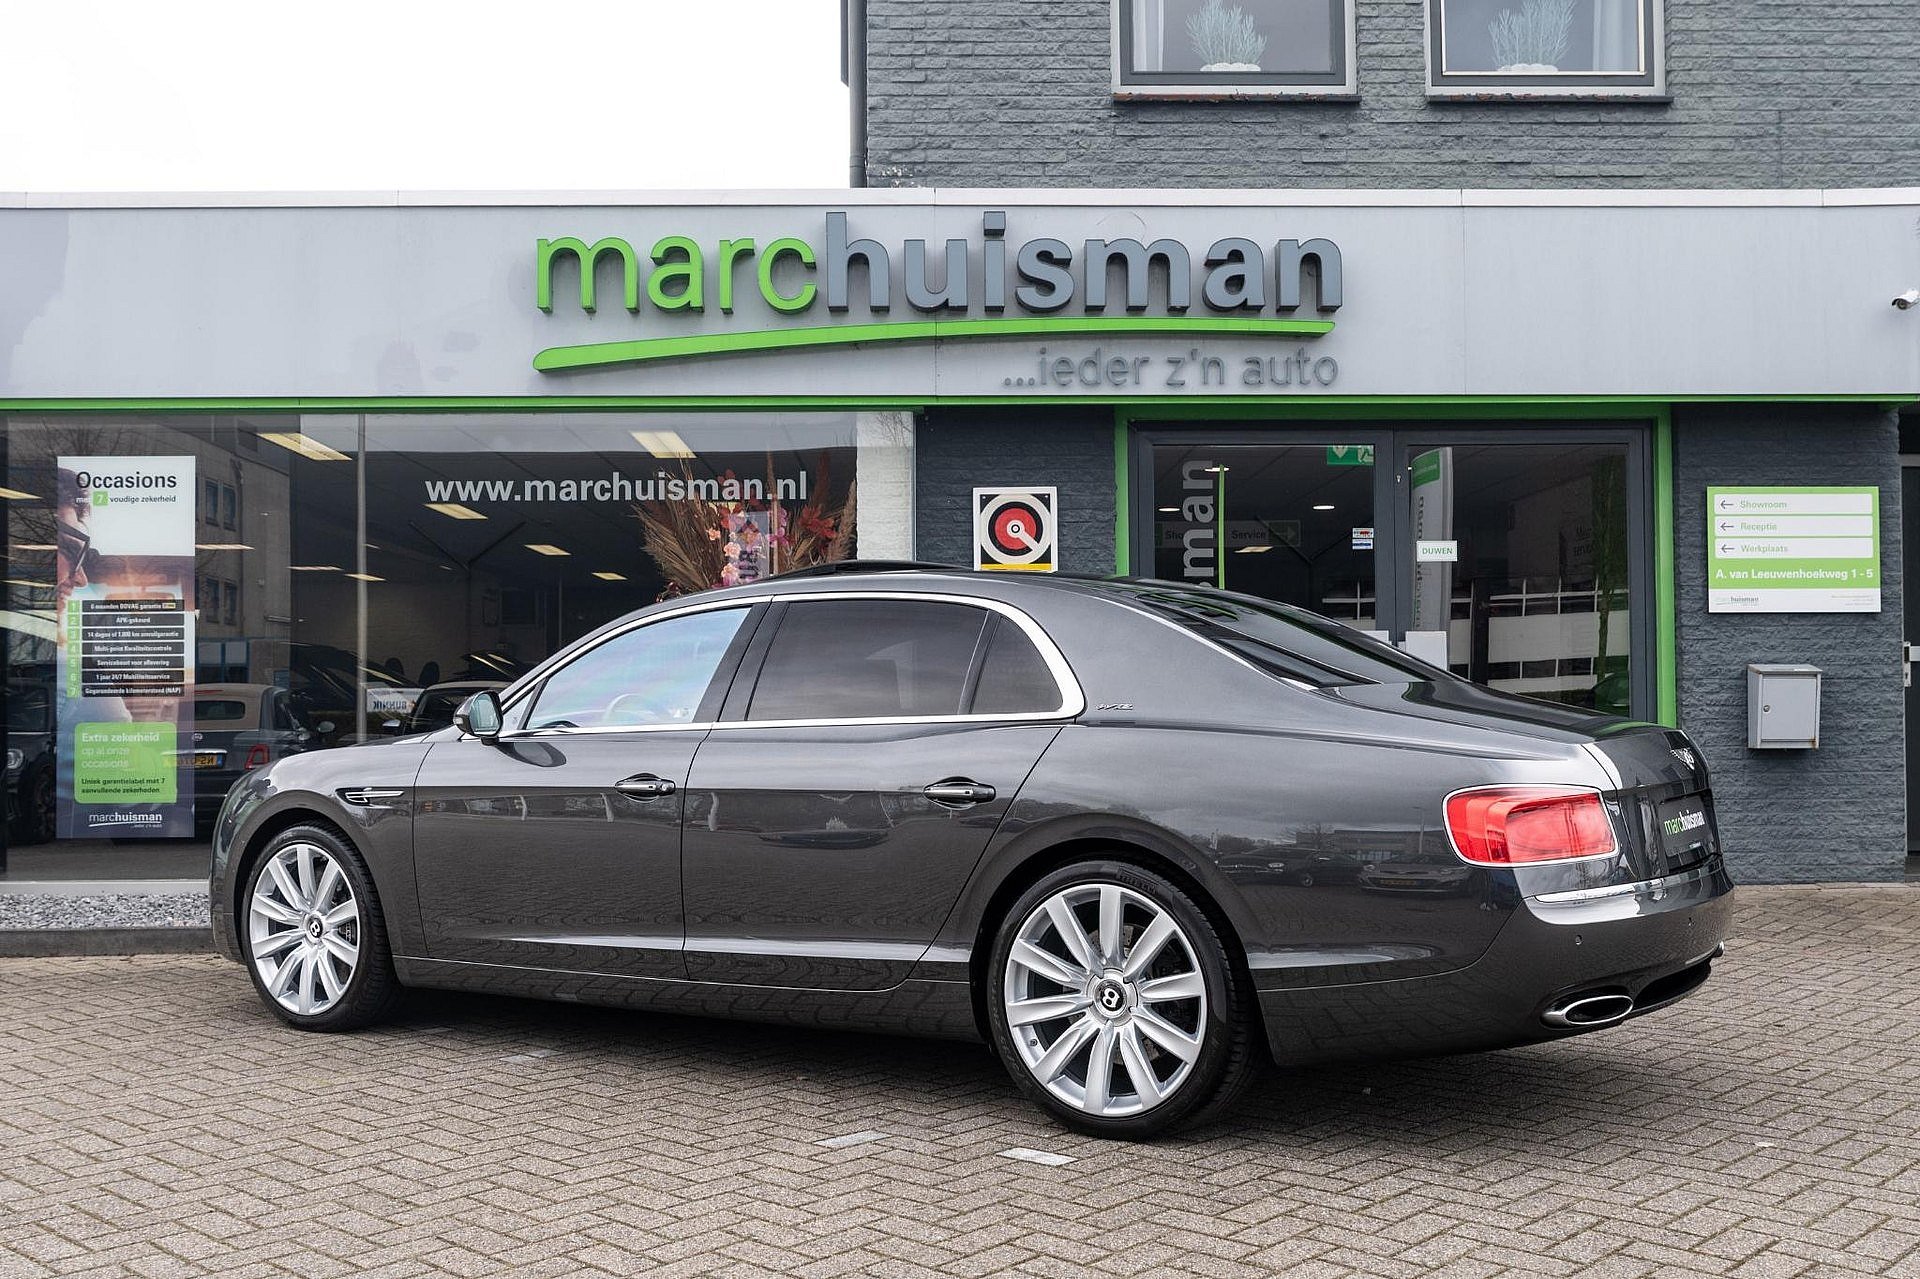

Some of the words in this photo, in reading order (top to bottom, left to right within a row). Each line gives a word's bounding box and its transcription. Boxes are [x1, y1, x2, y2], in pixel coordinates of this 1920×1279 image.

[537, 211, 1343, 314] marchuisman
[1167, 349, 1225, 387] z'n
[1242, 349, 1339, 387] auto
[75, 471, 177, 489] Occasions
[424, 471, 808, 502] www.marchuisman.nl
[109, 495, 140, 504] voudige
[141, 495, 177, 503] zekerheid
[1739, 499, 1788, 509] Showroom
[1183, 460, 1214, 589] man
[1740, 521, 1778, 532] Receptie
[1422, 547, 1453, 555] DUWEN
[1740, 543, 1789, 554] Werkplaats
[1715, 568, 1727, 579] A.
[1729, 570, 1749, 579] van
[1751, 568, 1848, 581] Leeuwenhoekweg
[1851, 568, 1858, 579] 1
[1866, 568, 1874, 579] 5
[82, 733, 109, 742] Extra
[111, 732, 160, 742] zekerheid
[88, 812, 162, 822] marchuisman
[1664, 809, 1706, 836] marchuisman
